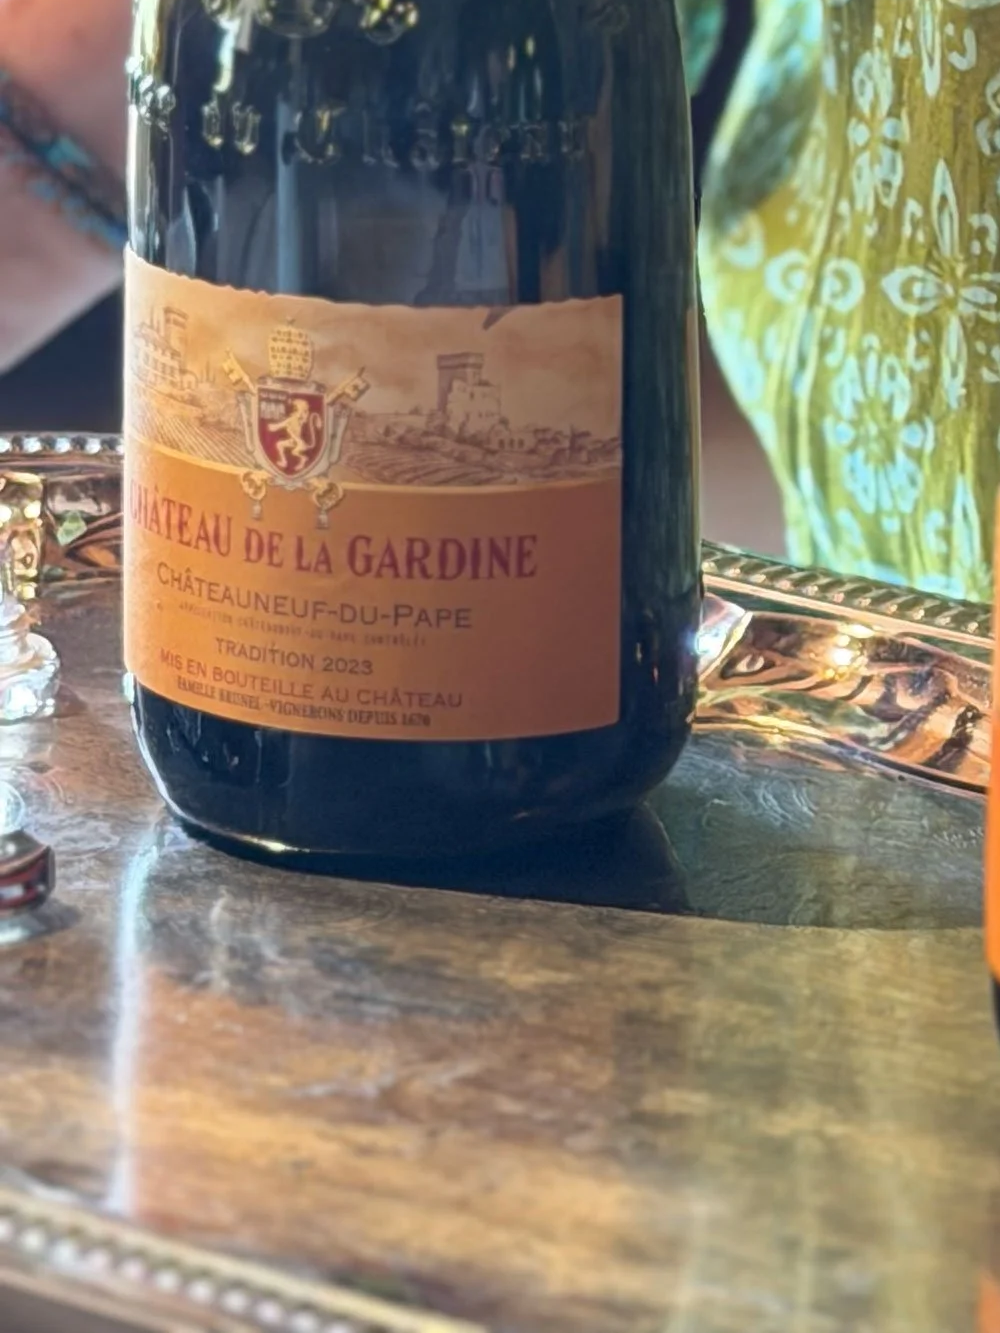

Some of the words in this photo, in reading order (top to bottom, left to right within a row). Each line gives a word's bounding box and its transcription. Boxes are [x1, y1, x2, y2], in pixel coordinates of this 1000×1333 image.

[243, 527, 285, 569] DE
[295, 535, 334, 574] LA
[346, 534, 539, 580] GARDINE
[156, 561, 473, 629] CHÂTEAUNEUF-DU-PAPE
[159, 647, 184, 672] MIS
[186, 658, 208, 678] EN
[212, 666, 315, 700] BOUTEILLE
[320, 686, 351, 704] AU
[356, 686, 464, 709] CHÂTEAU
[215, 636, 316, 671] TRADITION
[322, 656, 374, 676] 2023
